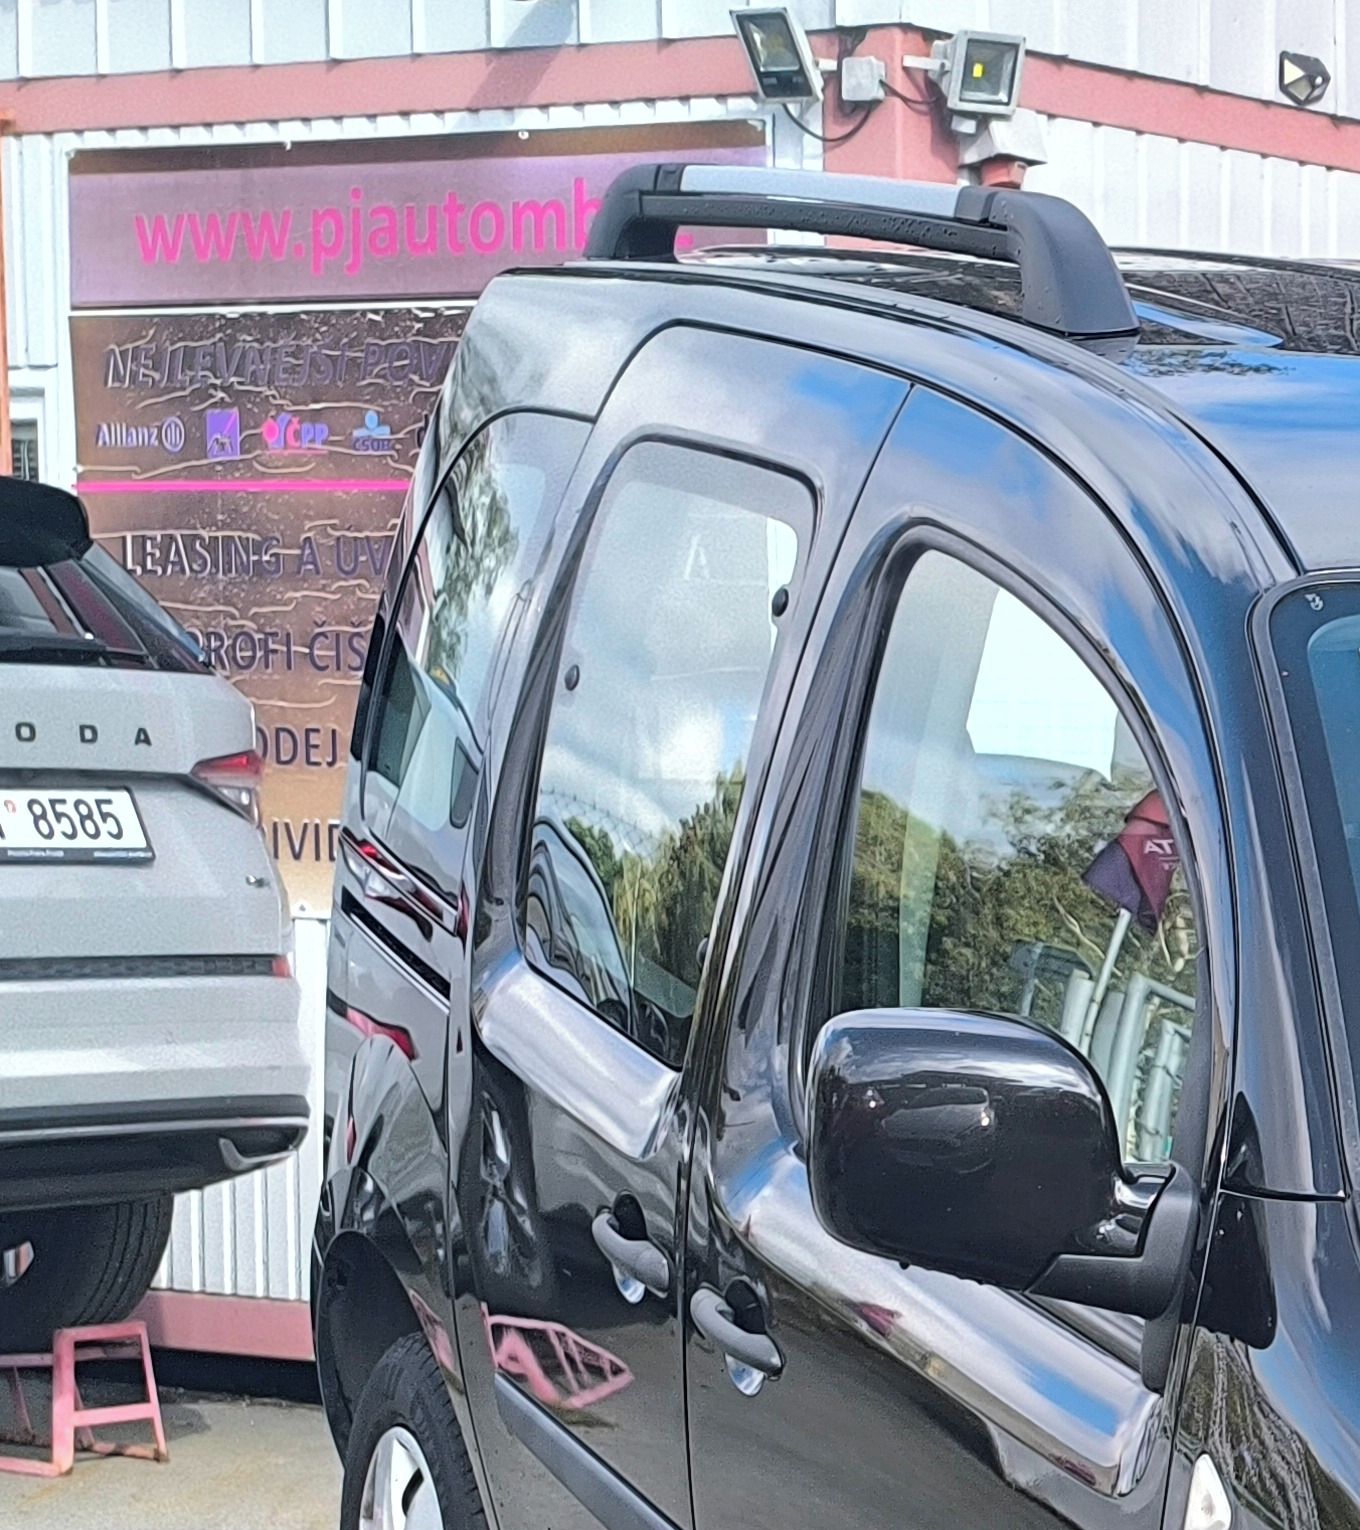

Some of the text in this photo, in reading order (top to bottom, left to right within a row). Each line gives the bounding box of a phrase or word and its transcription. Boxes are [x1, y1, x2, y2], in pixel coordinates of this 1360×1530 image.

[96, 422, 159, 448] Allianz
[123, 533, 286, 577] LEASING
[299, 535, 323, 577] A
[27, 798, 123, 841] 8585
